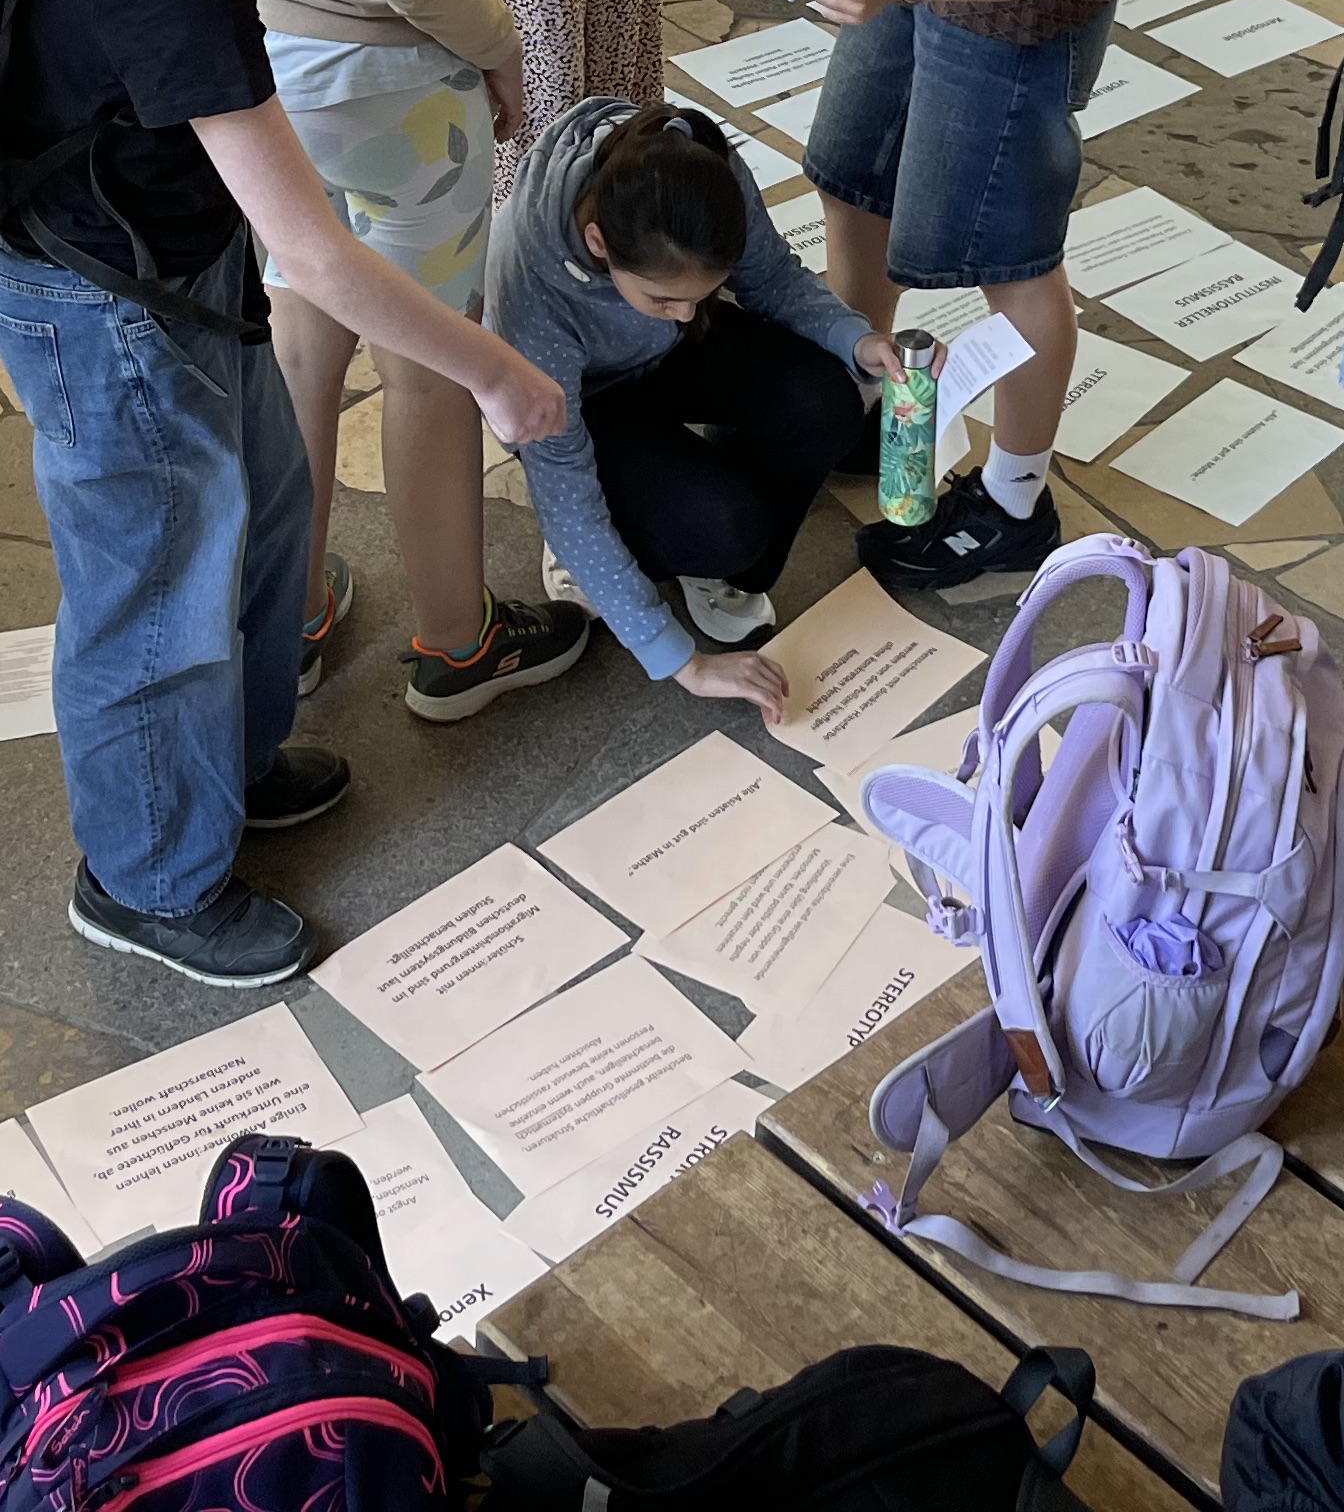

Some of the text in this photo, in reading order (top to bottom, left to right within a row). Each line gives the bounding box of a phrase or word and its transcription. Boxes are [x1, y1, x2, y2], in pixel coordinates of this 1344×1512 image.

[1223, 18, 1284, 41] Xenophobie
[1174, 276, 1282, 327] INSTITUTIONELLER
[1175, 274, 1244, 307] RASSISMUS
[1218, 447, 1231, 457] gut
[1229, 438, 1243, 449] sind
[890, 642, 918, 664] werden
[803, 642, 893, 714] ohne konkreten Verdacht
[864, 675, 878, 686] der
[876, 664, 892, 676] von
[823, 648, 937, 740] Menschen mit dunkler Hautfarbe
[840, 685, 866, 707] Polizei
[708, 794, 742, 818] Asiaten
[672, 829, 688, 843] gut
[689, 817, 708, 833] sind
[662, 841, 675, 849] in
[377, 894, 526, 992] deutschen Bildungssystem laut
[386, 896, 494, 964] Studien benachteiligt.
[392, 905, 540, 1002] Migrationshintergrund sind im
[436, 935, 524, 994] Schüler:innen mit
[559, 1037, 602, 1064] Absichten
[661, 1045, 675, 1055] die
[494, 1024, 654, 1118] Personen keine bewusst rassistischen
[509, 1036, 662, 1128] benachteiligen, auch wenn einzelne
[614, 1054, 662, 1084] bestimmte
[645, 1054, 692, 1082] Beschreibt
[113, 1057, 246, 1116] Nachbarschaft wollen.
[574, 1082, 614, 1107] Gruppen
[111, 1068, 260, 1136] anderen Ländern in ihrer
[270, 1103, 307, 1123] Einige
[574, 1079, 645, 1125] gesellschaftliche
[106, 1078, 281, 1156] weil sie keine Menschen aus
[94, 1084, 309, 1180] eine Unterkunft für Geflüchtete ab,
[116, 1166, 161, 1190] lehnen
[595, 1125, 682, 1218] RASSISMUS
[388, 1196, 416, 1213] Angst
[51, 1409, 90, 1455] Satch
